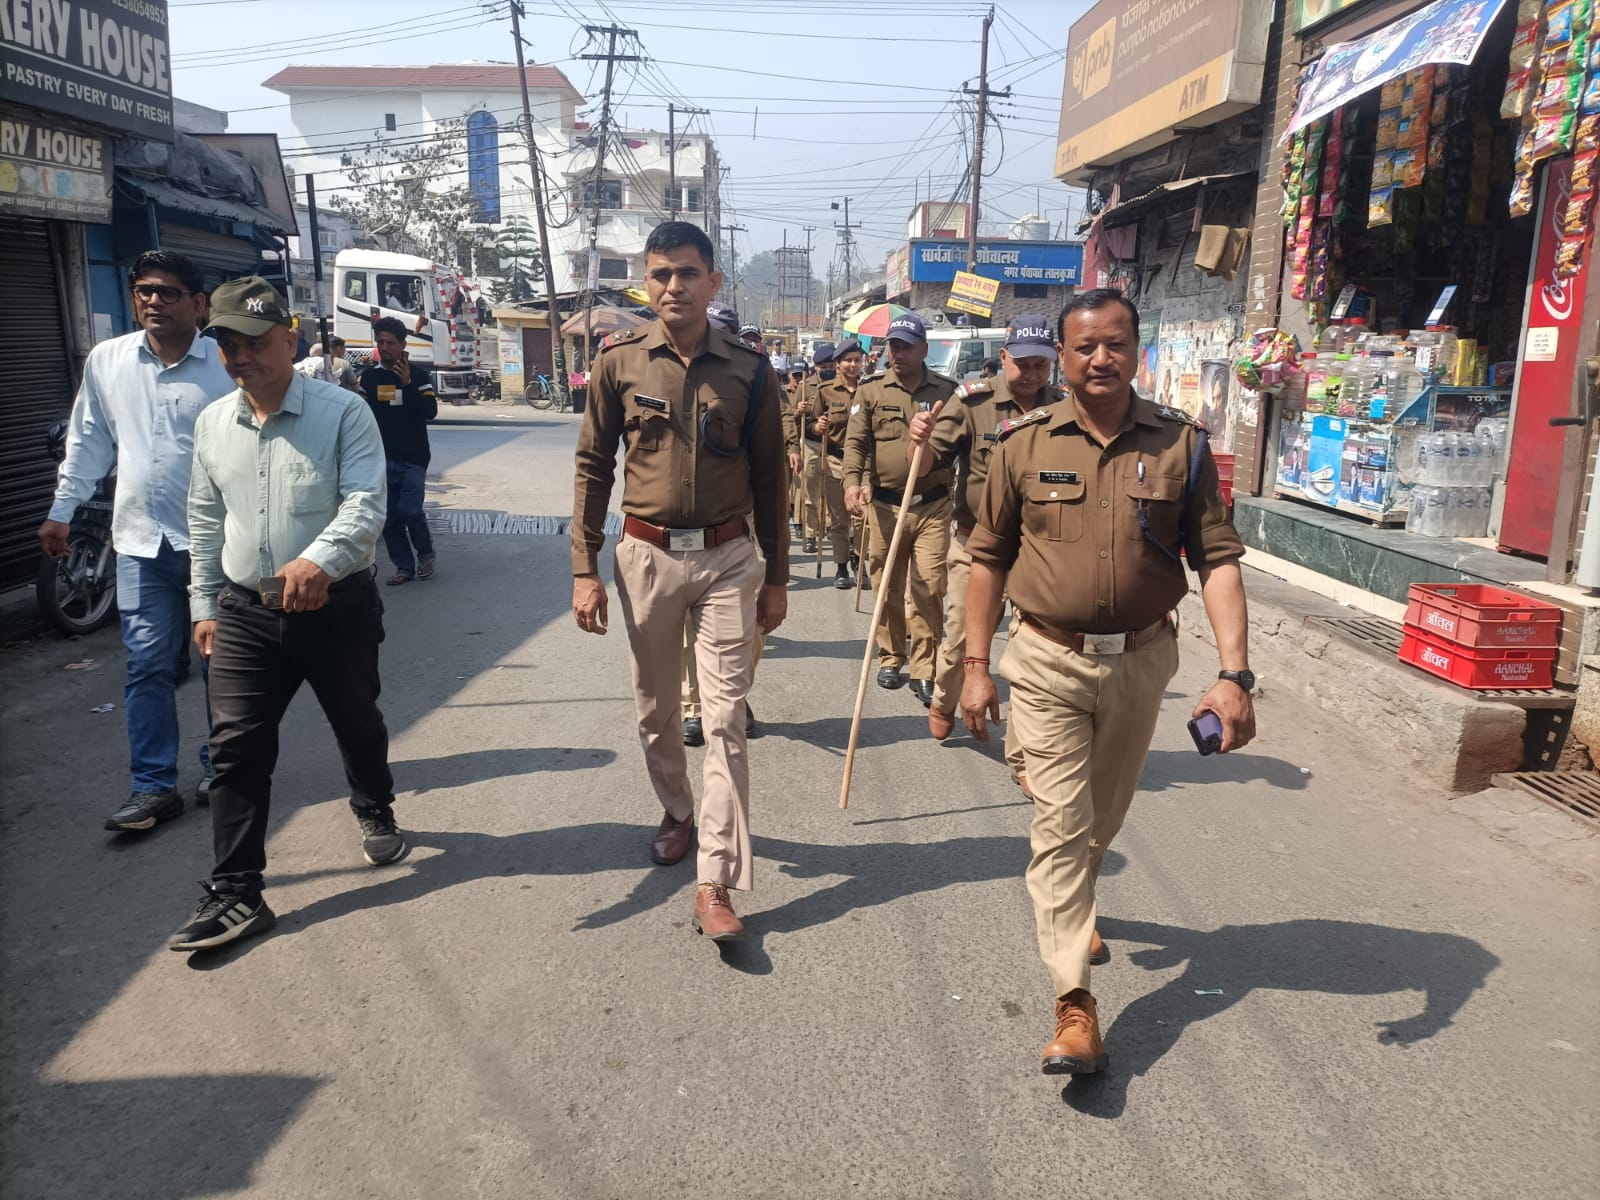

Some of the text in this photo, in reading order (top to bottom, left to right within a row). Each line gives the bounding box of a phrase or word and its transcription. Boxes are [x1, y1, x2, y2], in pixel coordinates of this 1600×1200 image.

[80, 8, 168, 92] HOUSE
[1086, 31, 1112, 92] pnb
[7, 62, 171, 126] PASTRY EVERY DAY FRESH
[1179, 74, 1209, 112] ATM
[36, 128, 103, 169] HOUSE
[891, 321, 915, 330] POLICE
[1017, 327, 1050, 339] POLICE
[1495, 663, 1534, 674] AANCHAL
